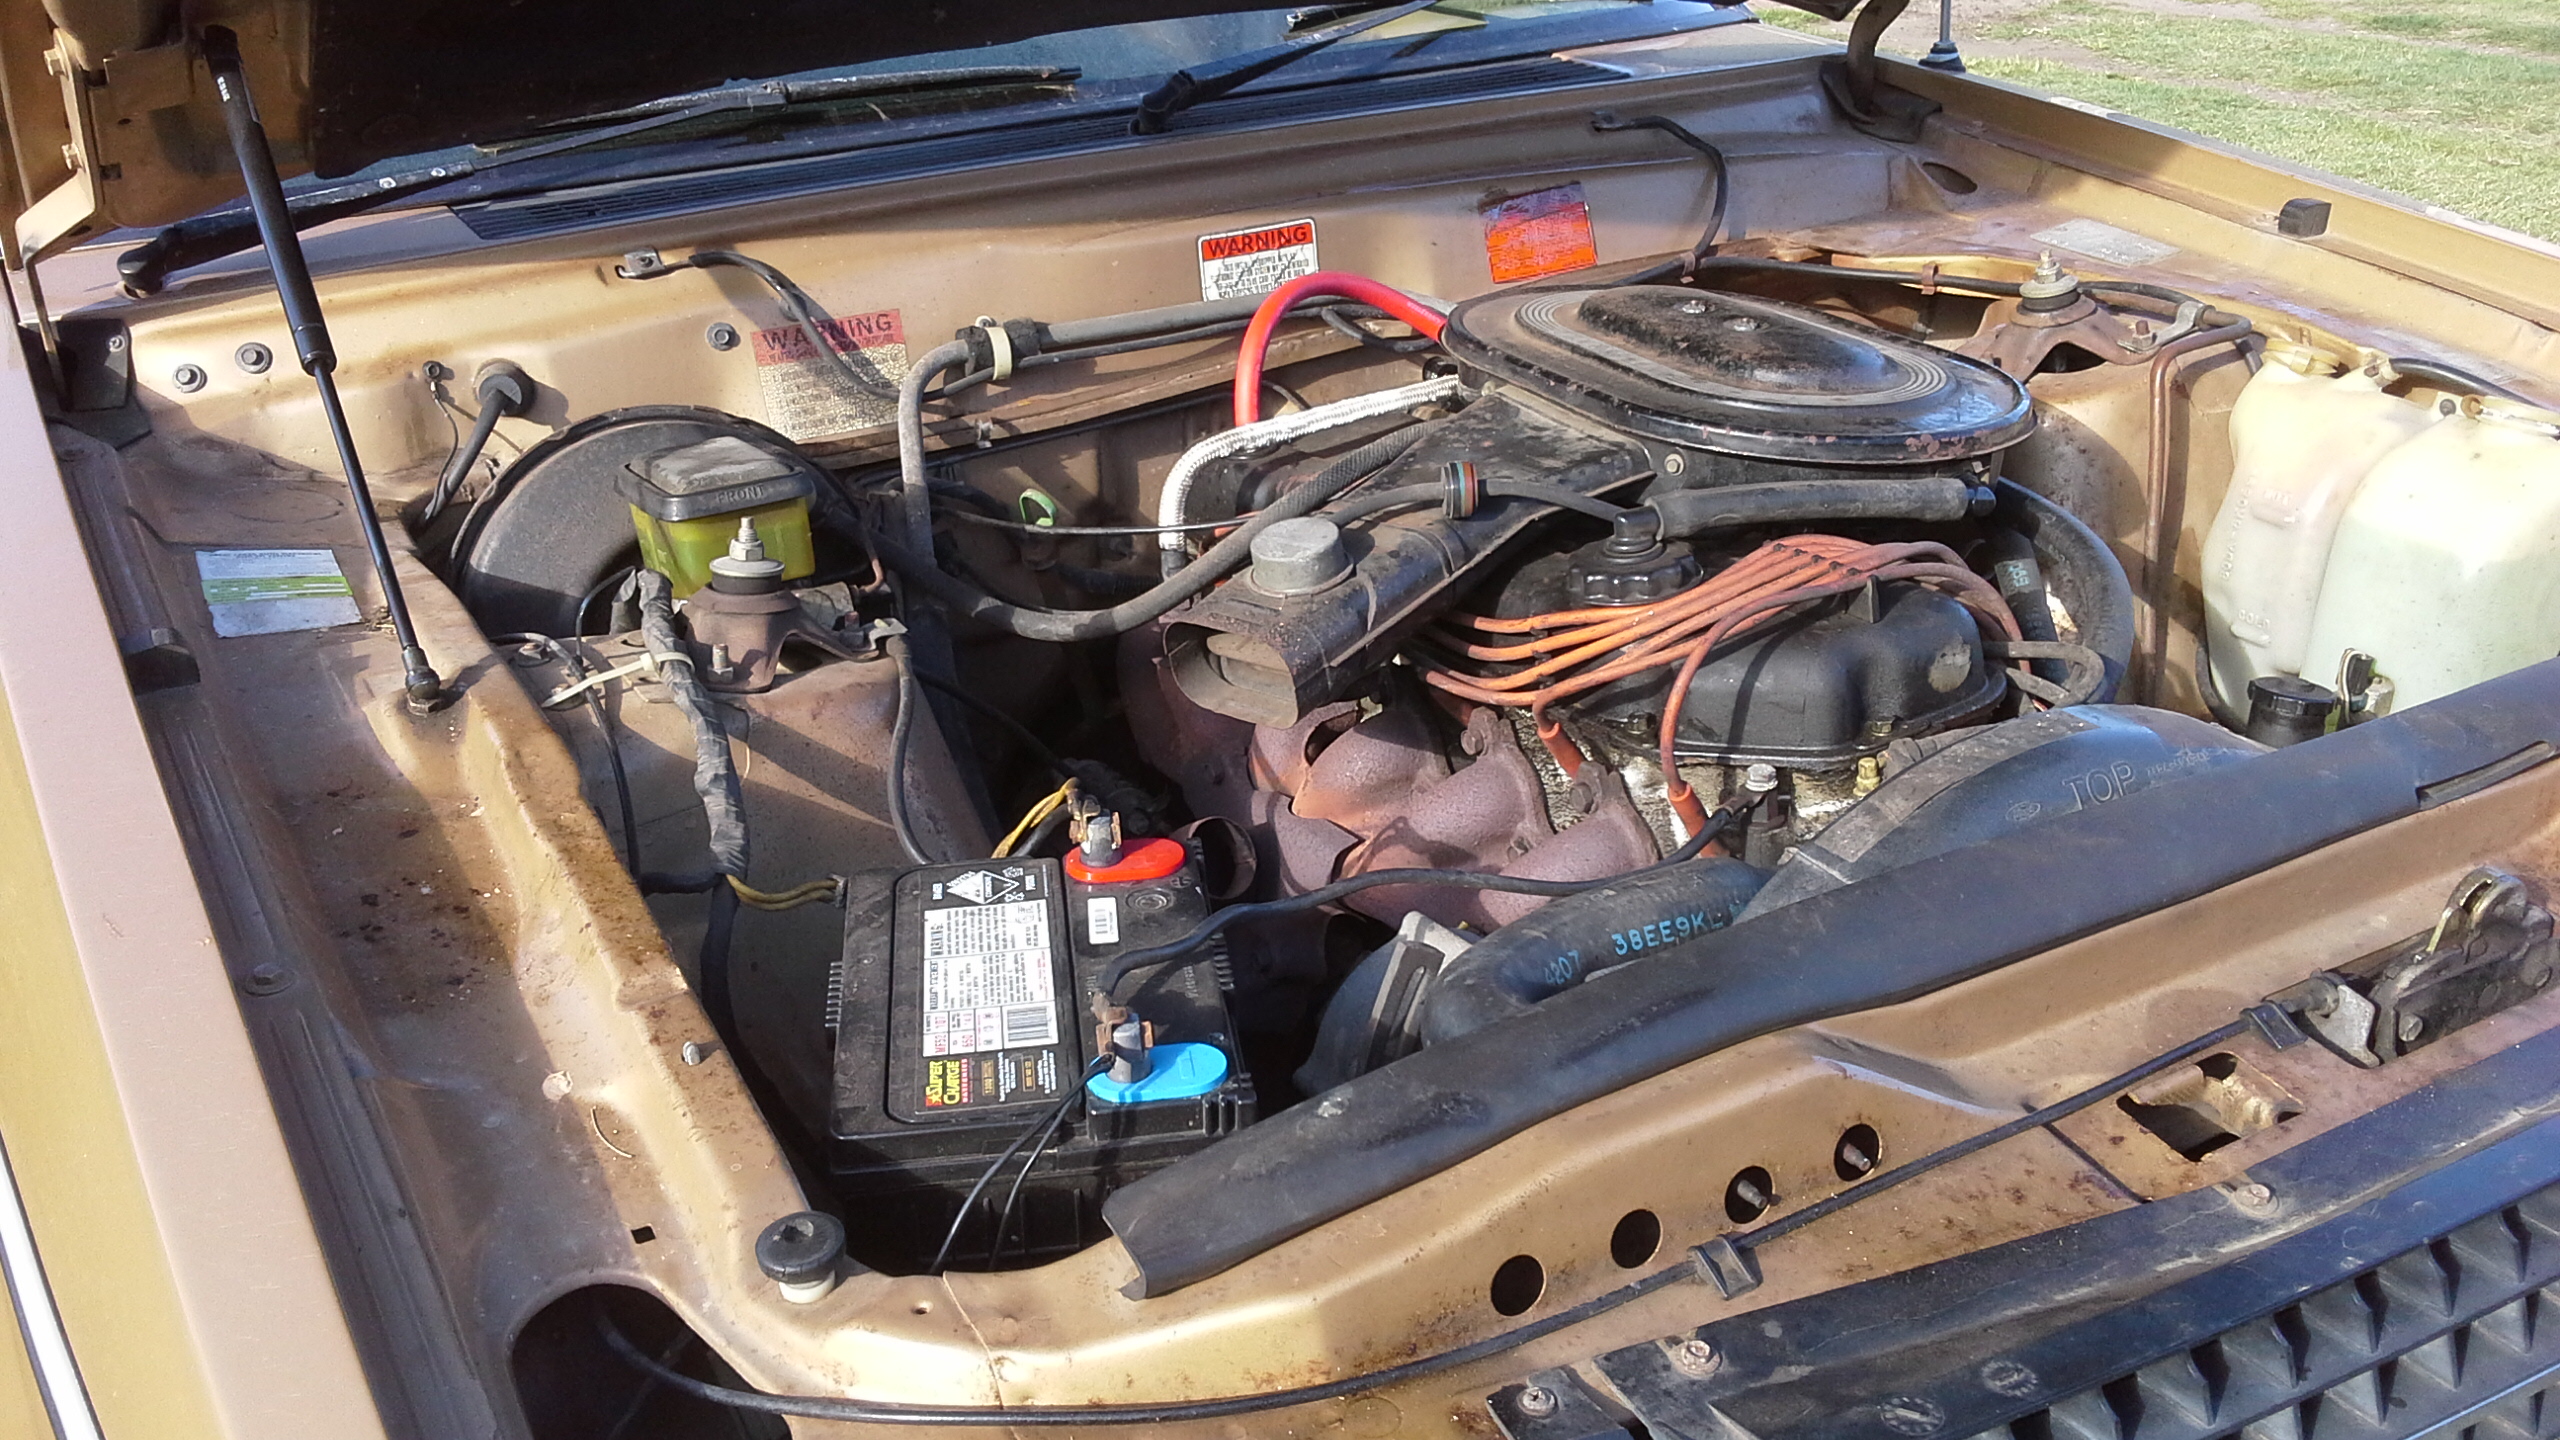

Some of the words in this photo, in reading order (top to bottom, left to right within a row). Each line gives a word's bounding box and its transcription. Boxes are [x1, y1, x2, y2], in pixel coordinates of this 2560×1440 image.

[1208, 226, 1308, 257] WARNING
[763, 313, 892, 350] WANING
[717, 484, 765, 504] FRONT
[2062, 759, 2135, 810] TOP
[926, 1061, 943, 1096] SUPER
[943, 1061, 960, 1105] CHARGE
